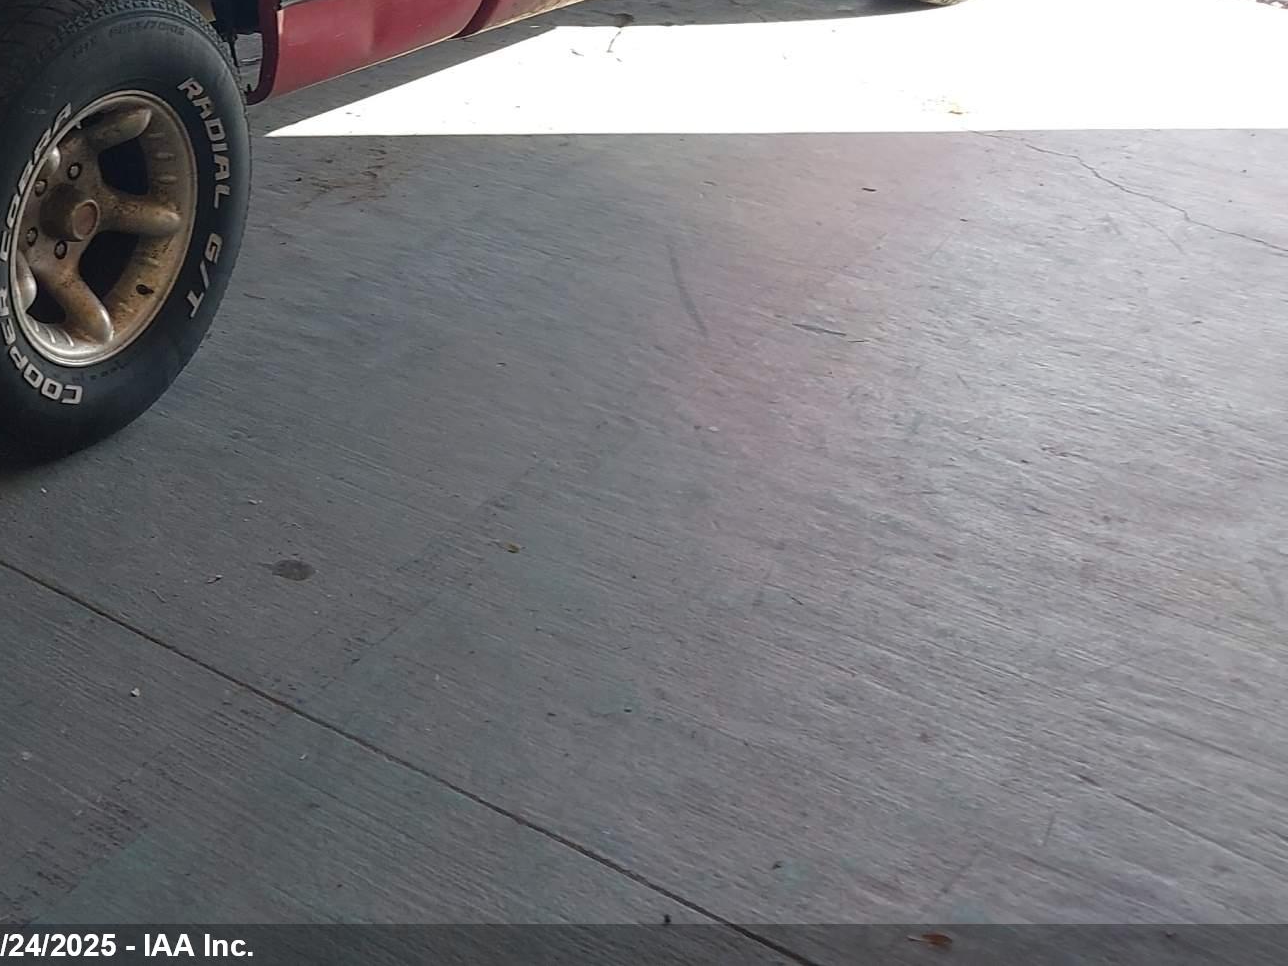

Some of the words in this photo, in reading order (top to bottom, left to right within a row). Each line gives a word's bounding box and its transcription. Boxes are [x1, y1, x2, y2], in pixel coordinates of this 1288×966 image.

[0, 102, 72, 263] COBRA
[177, 76, 231, 210] RADIAL
[186, 232, 225, 319] G/T
